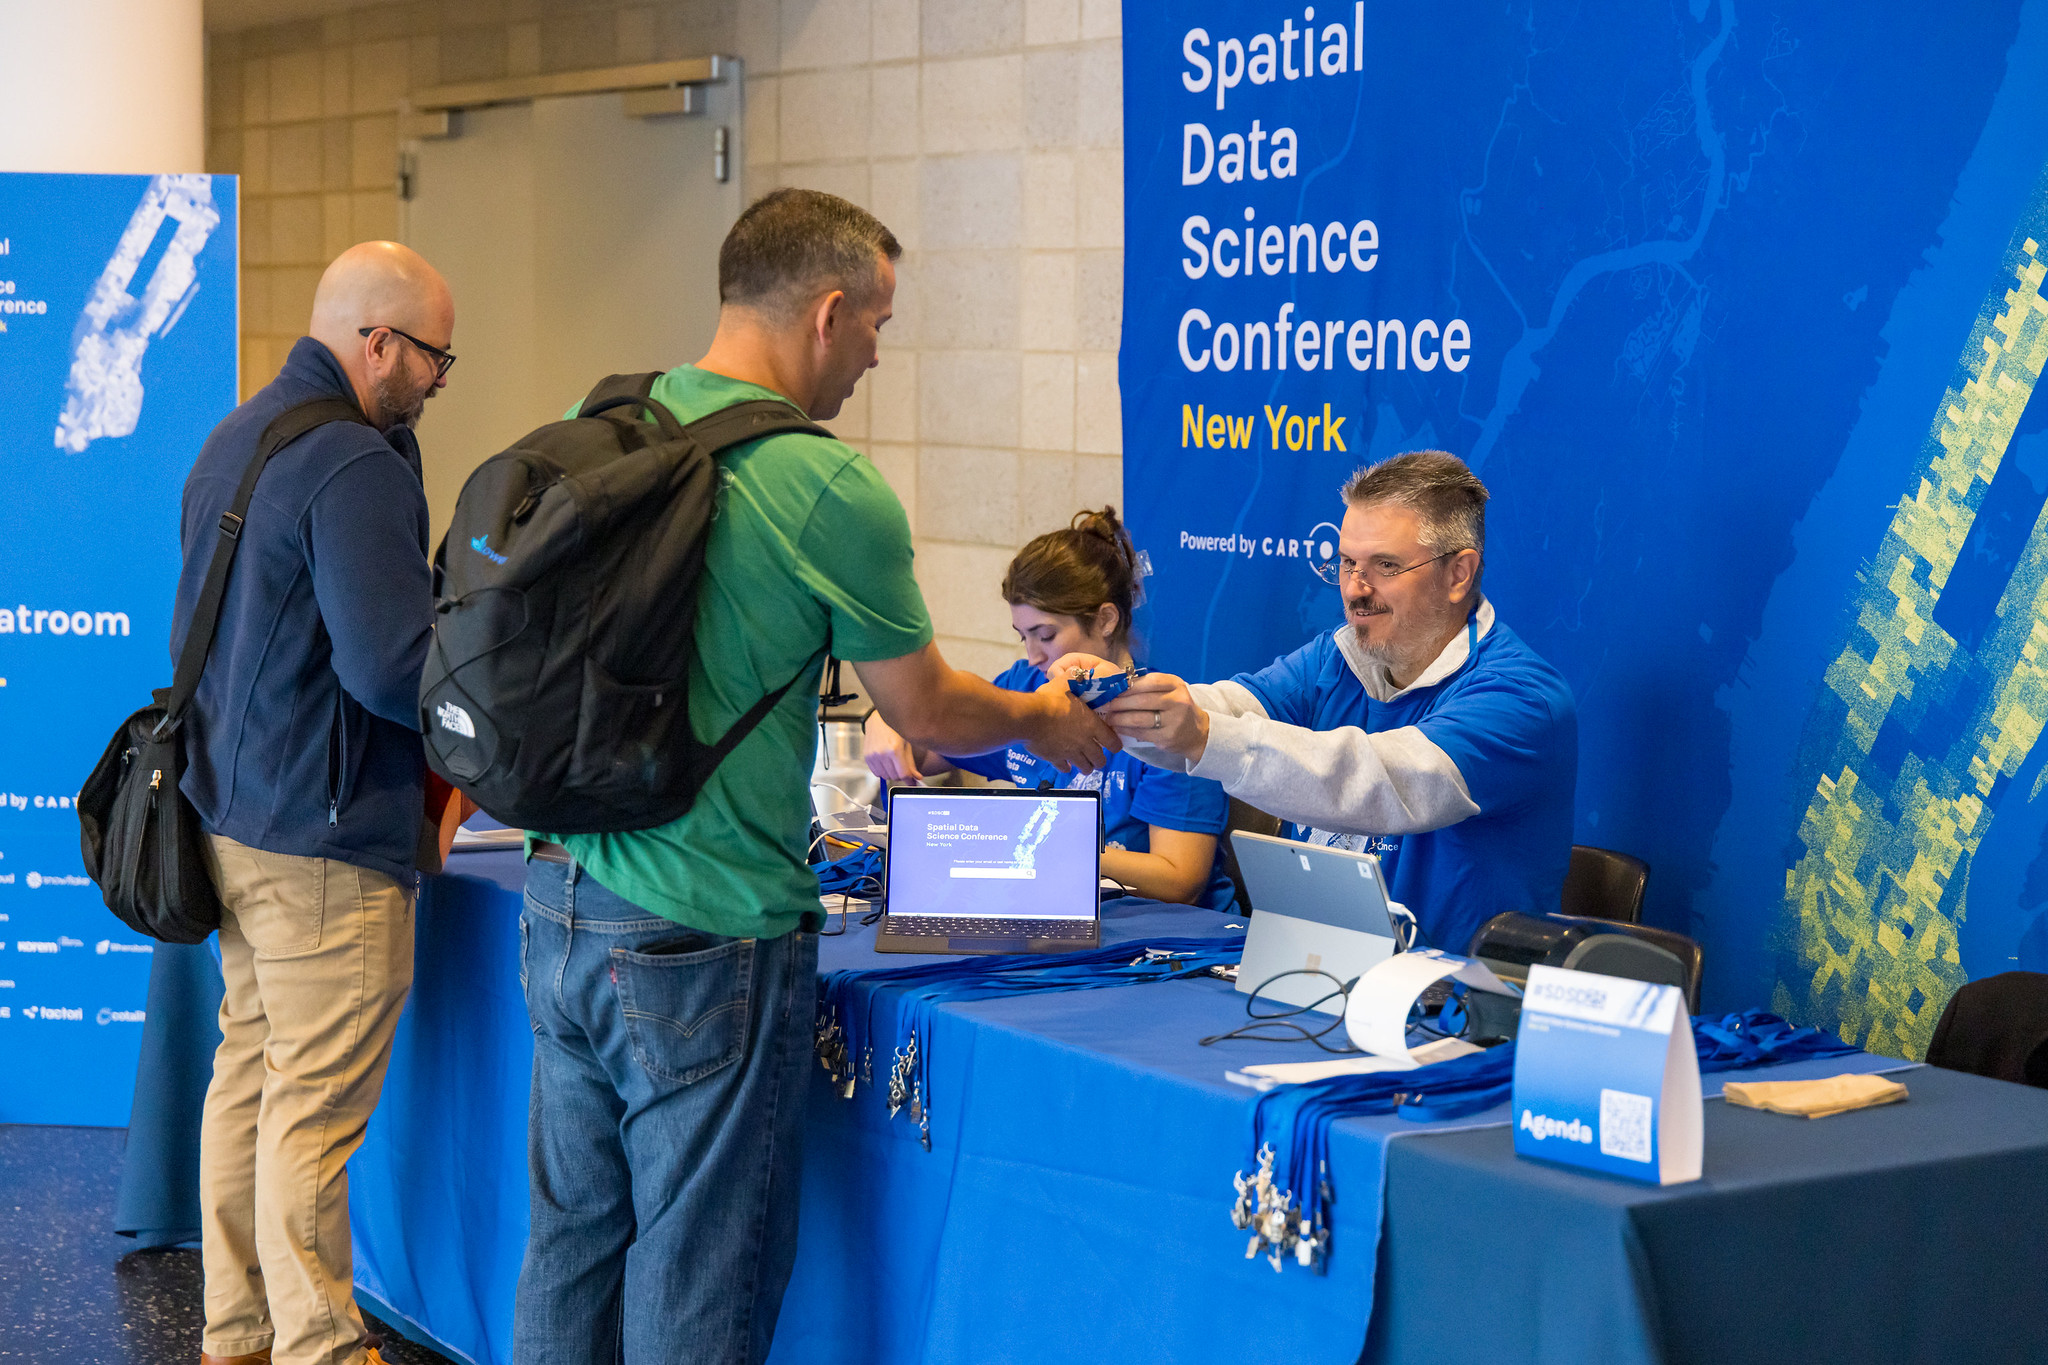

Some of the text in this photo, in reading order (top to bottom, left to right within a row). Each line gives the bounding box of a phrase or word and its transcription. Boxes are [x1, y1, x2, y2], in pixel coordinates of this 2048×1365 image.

[1182, 1, 1364, 110] Spatial
[1182, 119, 1298, 186] Data
[1182, 206, 1379, 280] Science
[1178, 302, 1471, 372] Conference
[1182, 403, 1347, 451] New York
[1180, 531, 1236, 552] Powered
[1239, 534, 1256, 559] by
[0, 604, 130, 637] atroom
[1007, 748, 1037, 766] Spatial
[10, 792, 29, 811] by
[926, 832, 1008, 841] Science Conference
[927, 823, 979, 832] Spatial Data
[1520, 1109, 1593, 1145] Agenda
